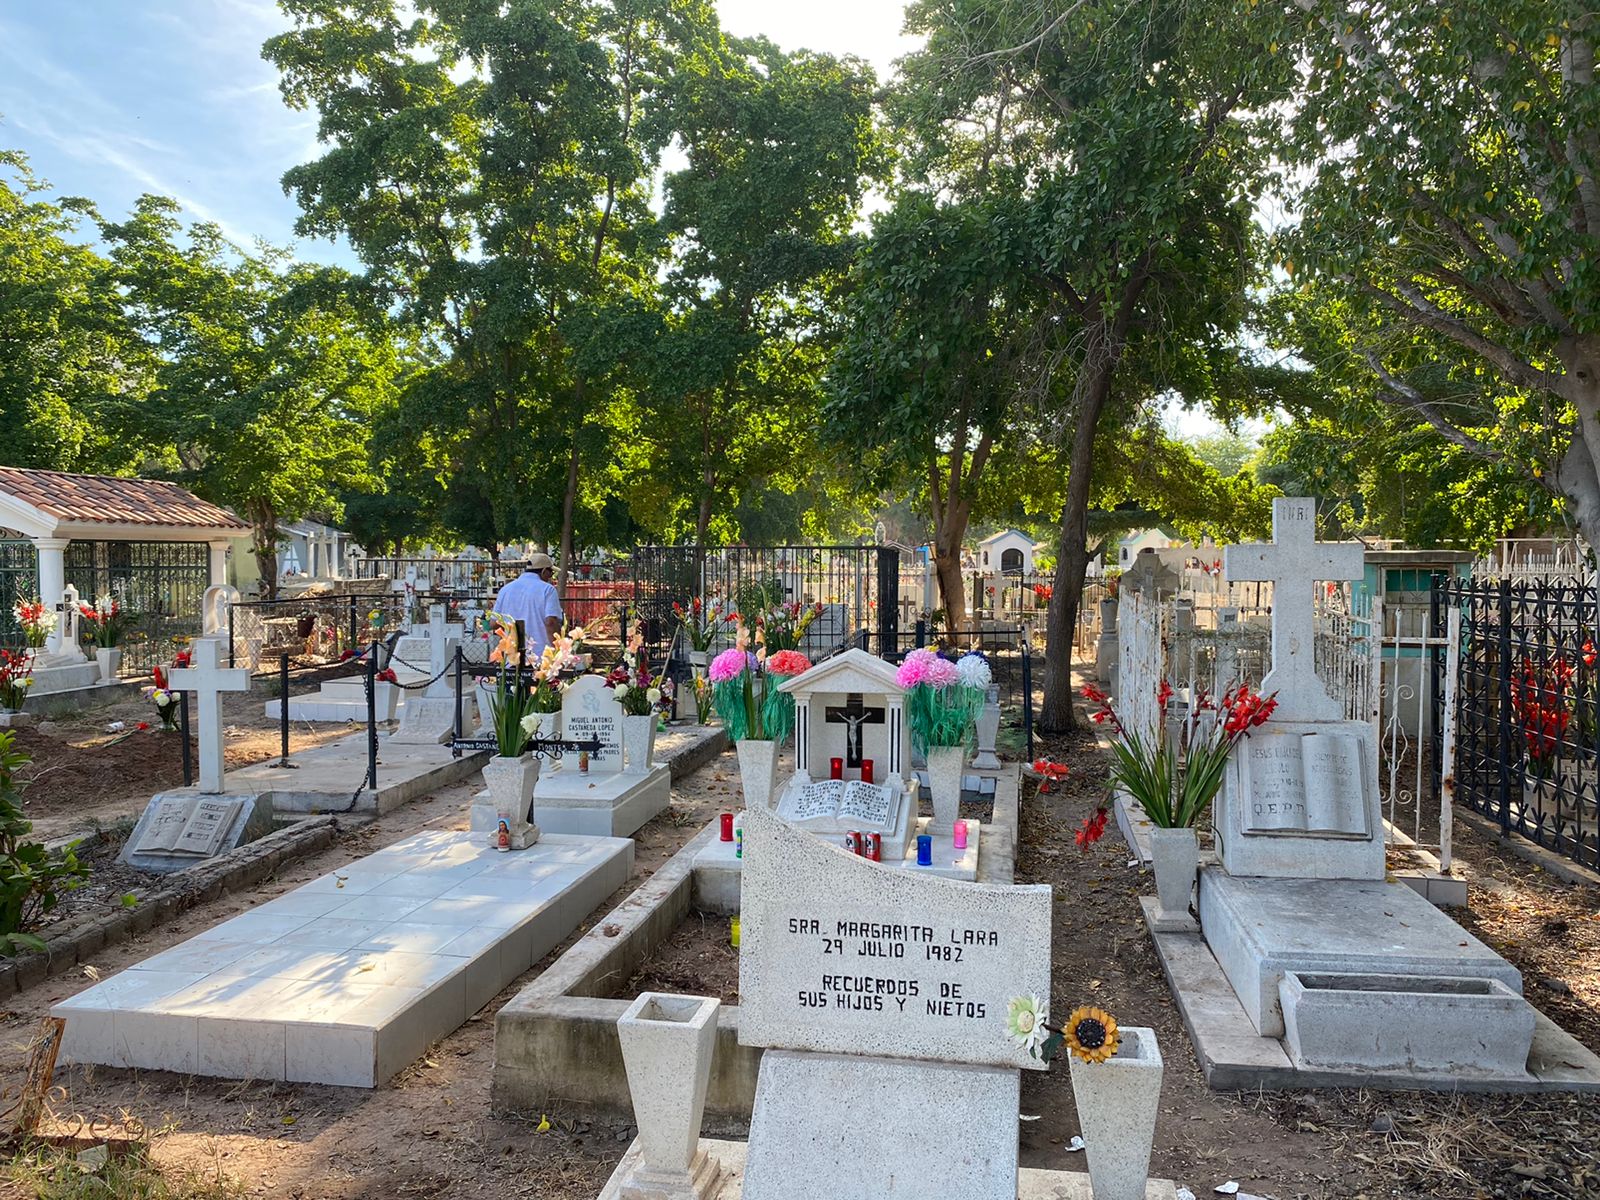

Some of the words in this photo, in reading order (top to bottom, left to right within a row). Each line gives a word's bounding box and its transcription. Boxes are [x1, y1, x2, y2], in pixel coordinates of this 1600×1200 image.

[836, 921, 934, 943] MARGARITA
[950, 929, 999, 946] LARA
[822, 938, 844, 955] 29
[858, 940, 905, 959] JULIO
[926, 945, 964, 963] 1982
[822, 974, 920, 997] RECUERDOS
[940, 982, 963, 999] DE
[798, 990, 827, 1008] SUS
[837, 994, 883, 1012] HIJOS
[895, 996, 907, 1012] Y
[926, 999, 986, 1019] NIETOS
